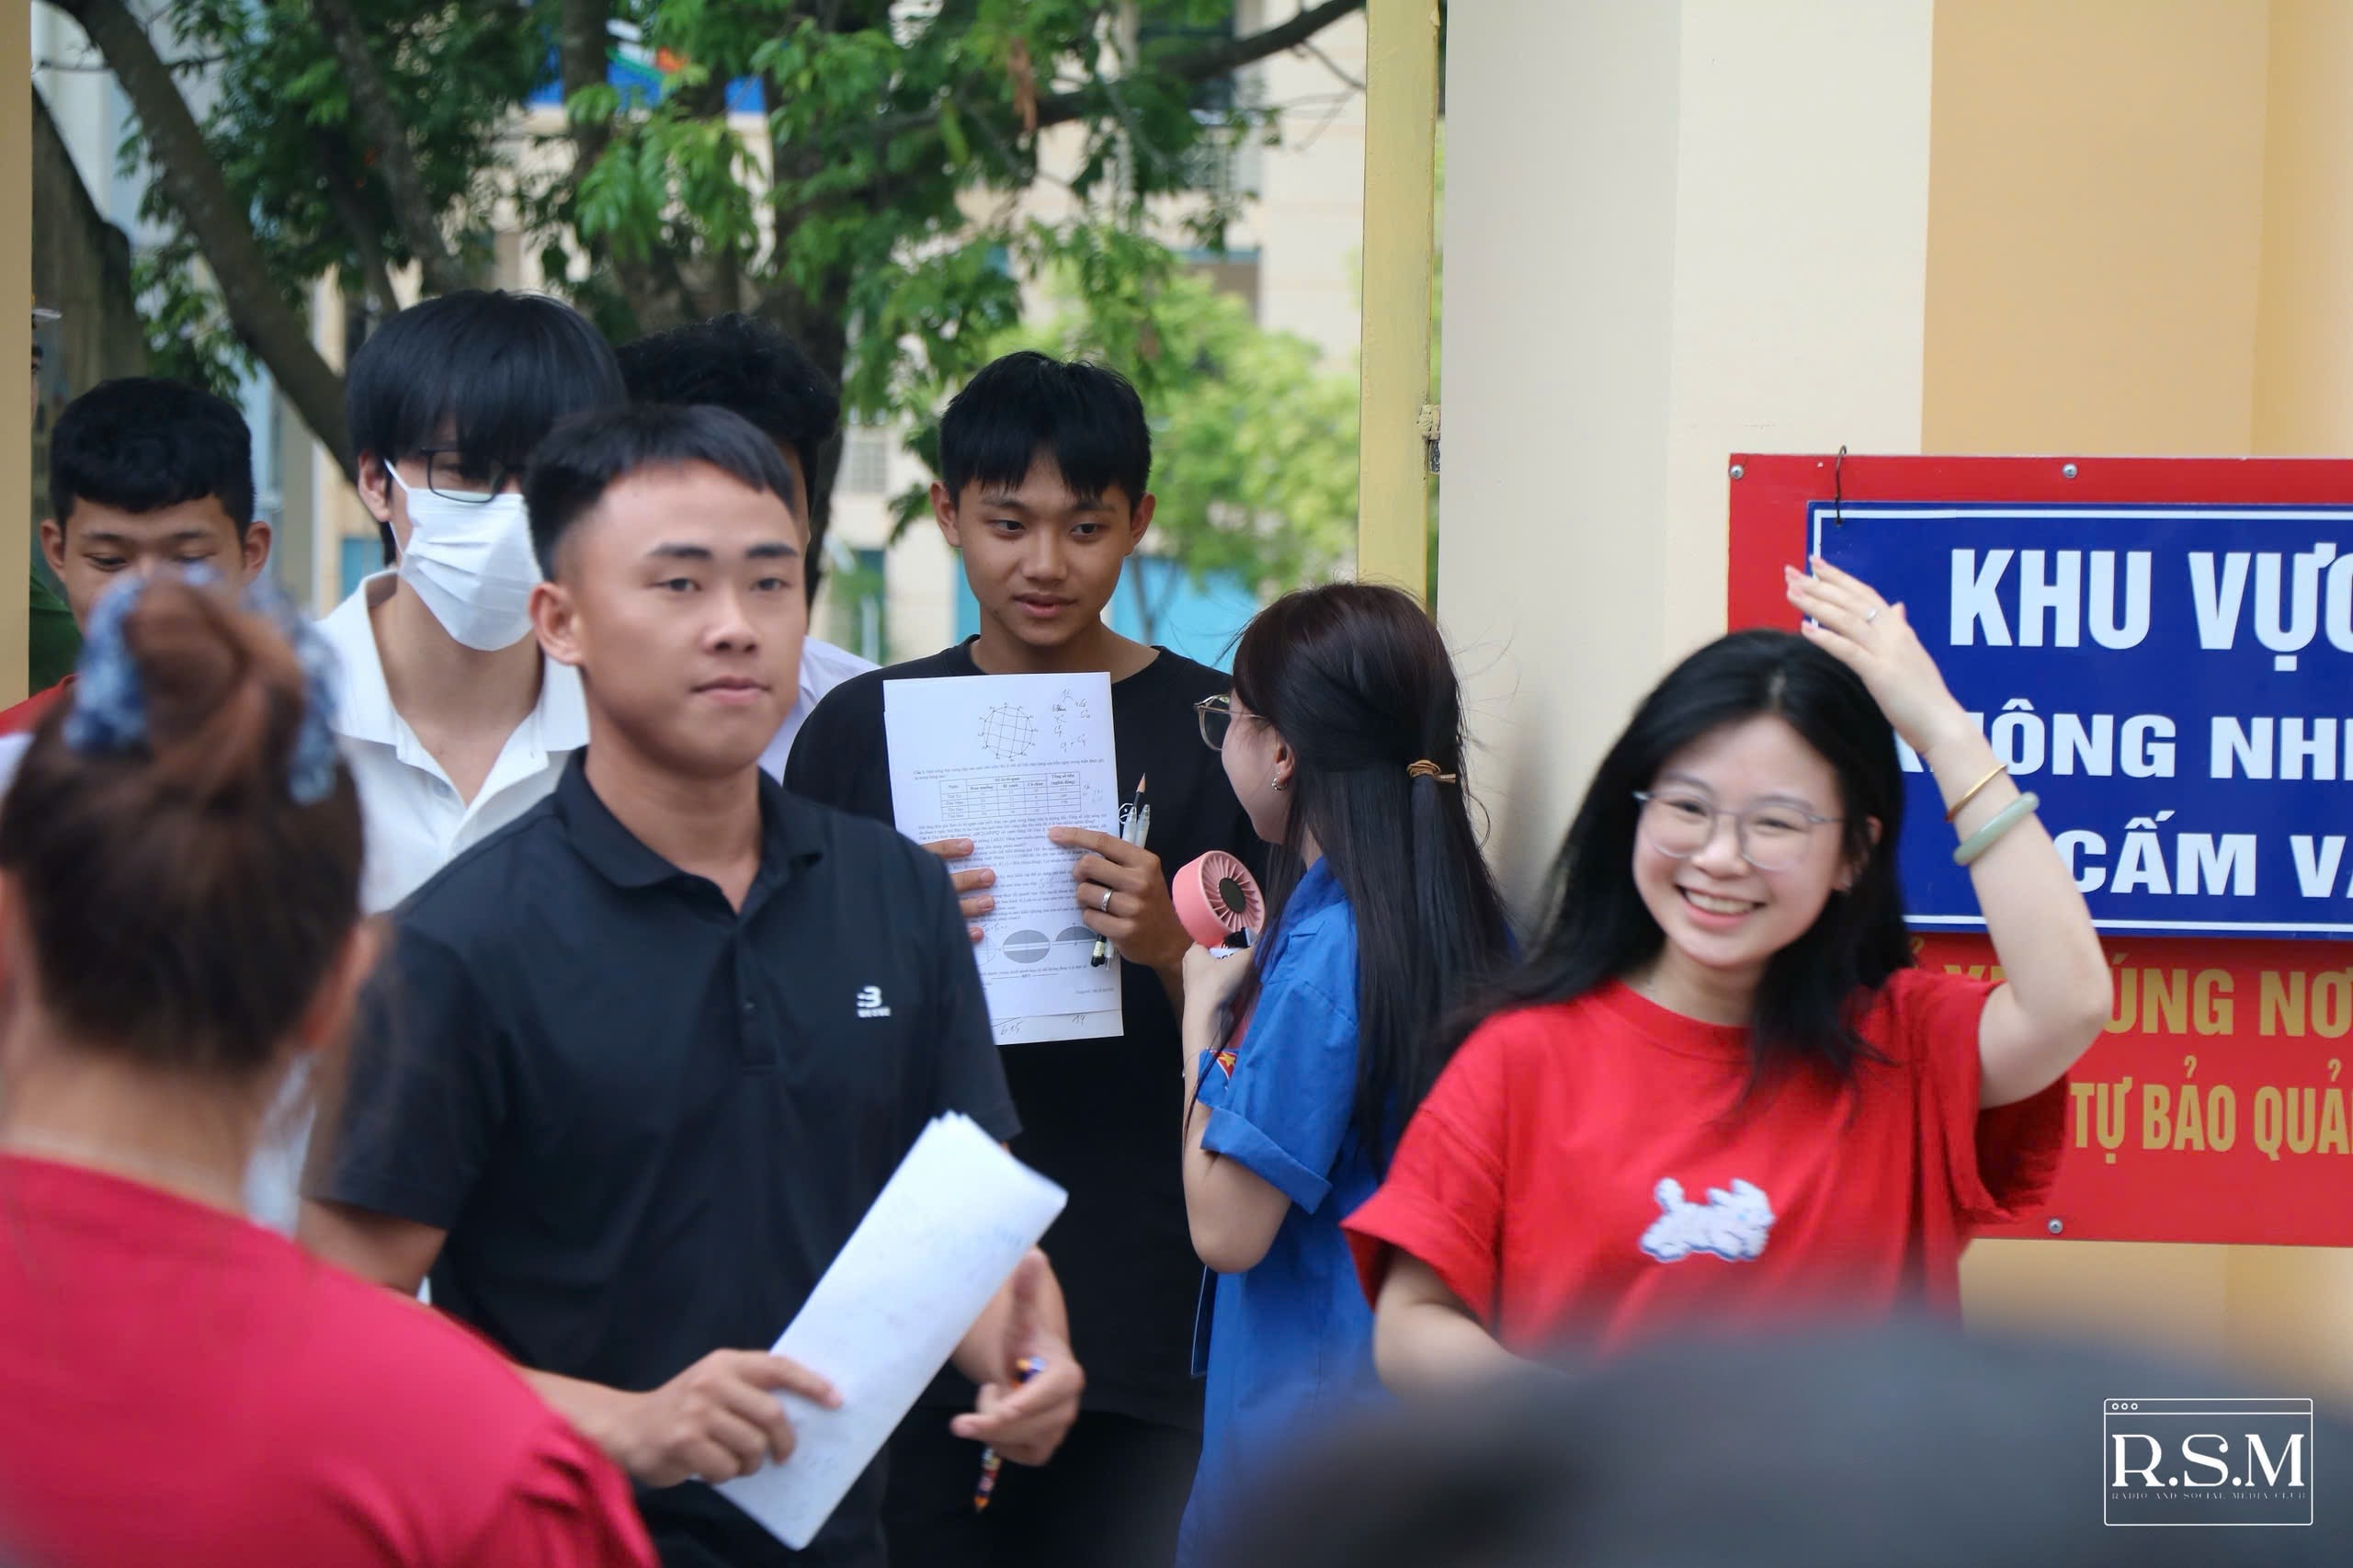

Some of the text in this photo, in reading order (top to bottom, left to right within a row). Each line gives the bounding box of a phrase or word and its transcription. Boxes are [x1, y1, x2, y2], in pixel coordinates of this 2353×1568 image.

[1950, 549, 2152, 649] KHU
[1893, 698, 2353, 781] ÔNG NH
[2052, 810, 2353, 899] CẤM V
[2070, 1055, 2353, 1164] TỰ BẢO QUẢ
